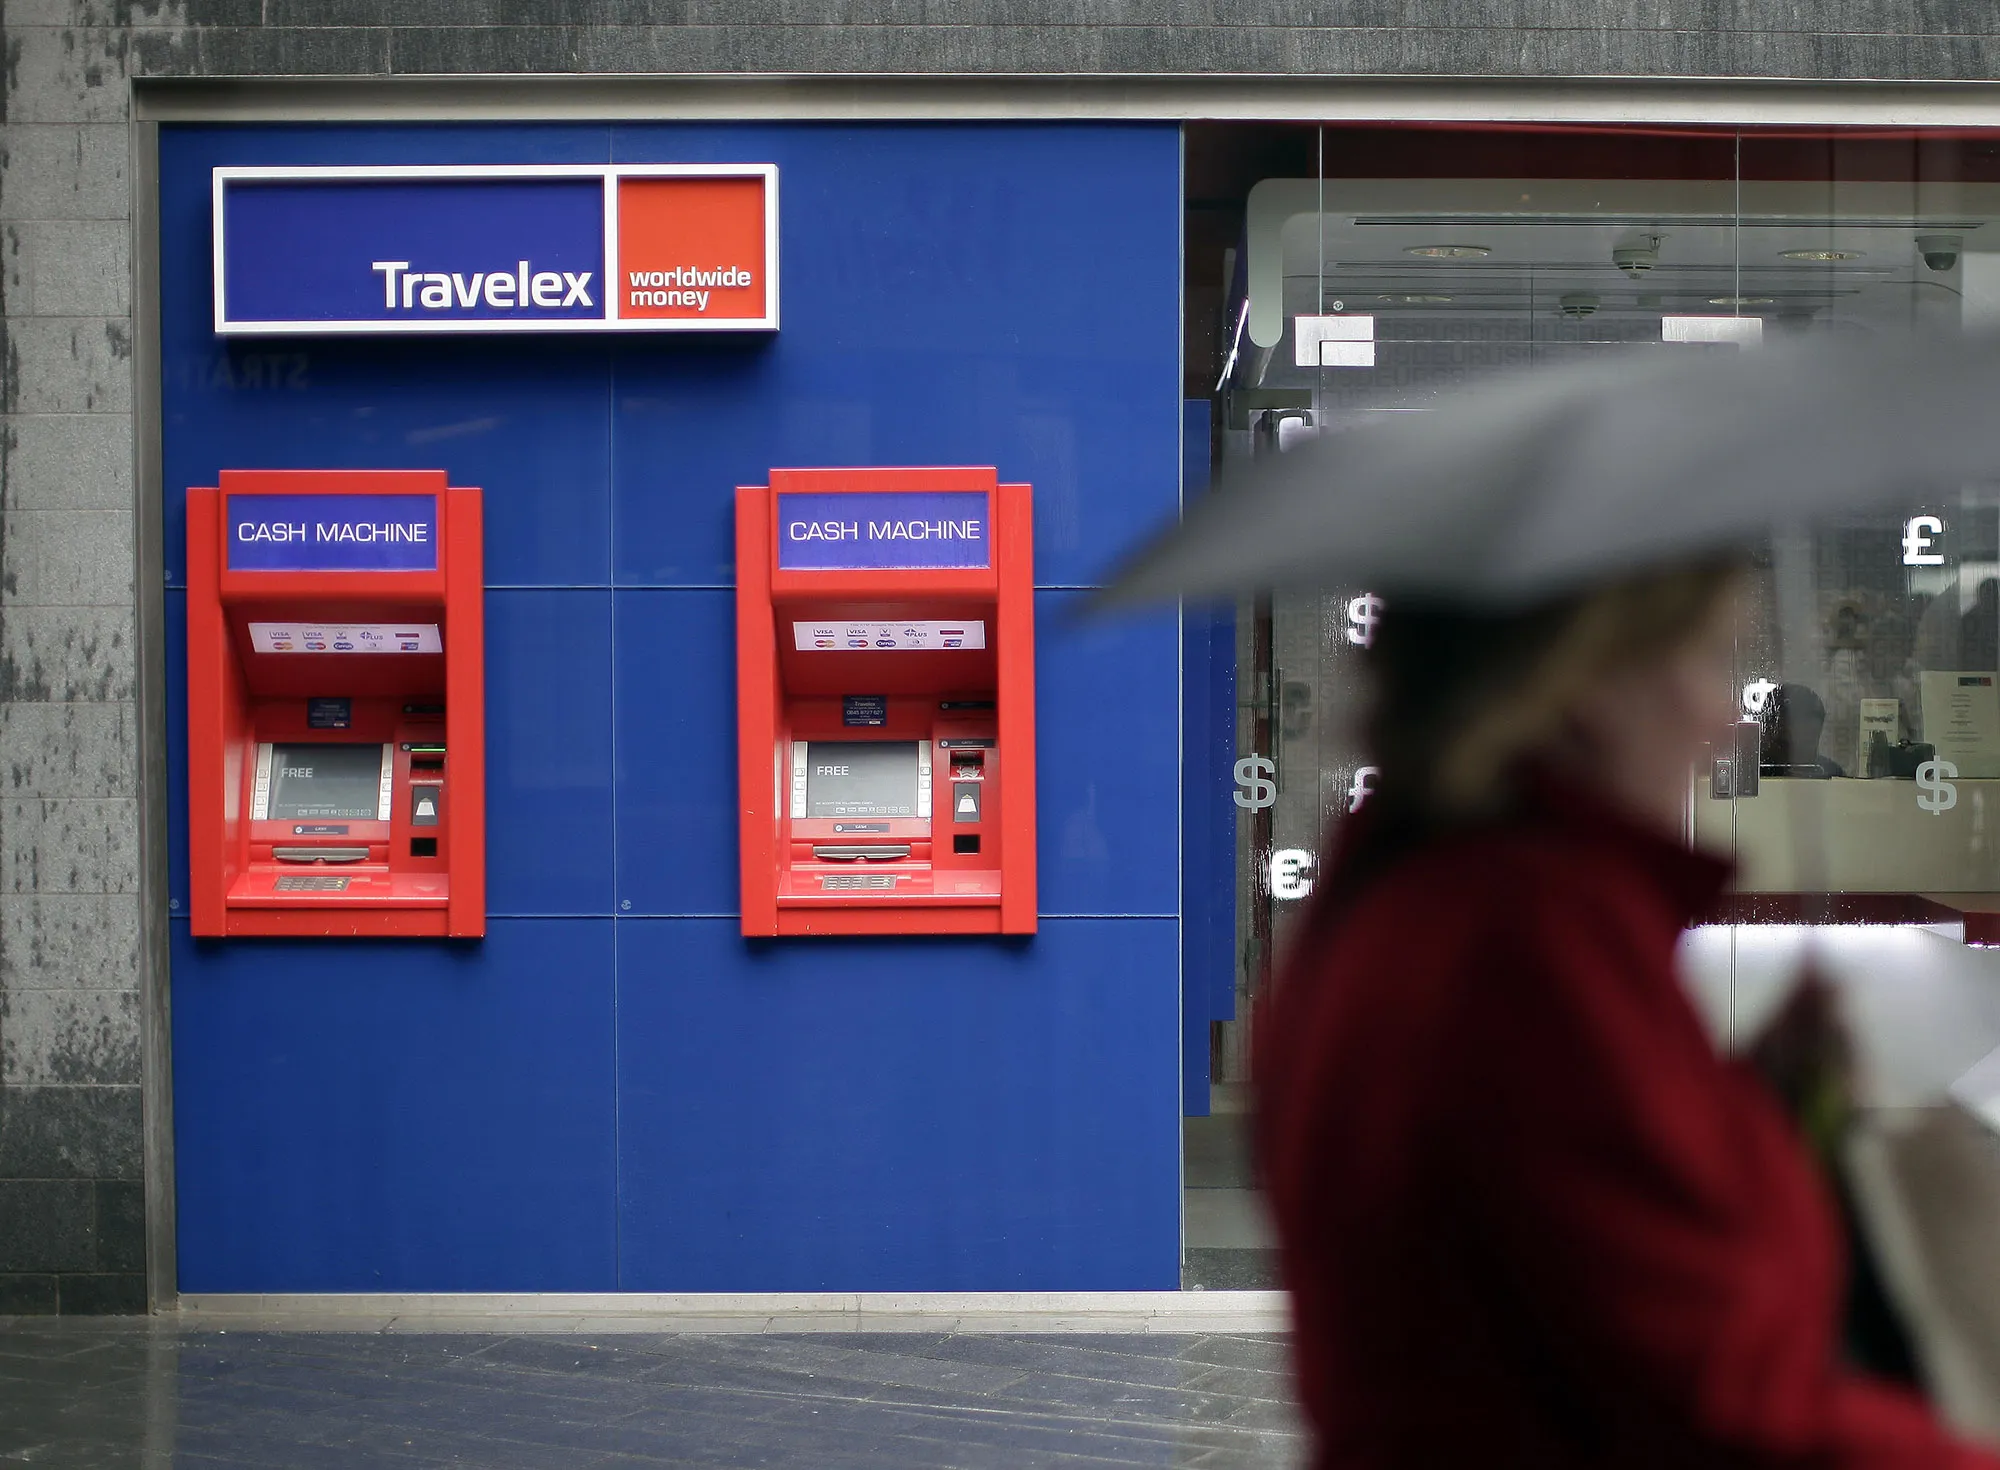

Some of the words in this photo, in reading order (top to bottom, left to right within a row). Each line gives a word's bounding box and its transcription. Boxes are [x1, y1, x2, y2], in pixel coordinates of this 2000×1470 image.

[373, 260, 594, 309] Travelex
[629, 265, 751, 288] worldwide
[629, 289, 710, 312] money
[237, 522, 305, 543] CASH
[316, 522, 428, 543] MACHINE
[789, 520, 858, 541] CASH
[868, 520, 981, 541] MACHINE
[1902, 515, 1945, 566] £
[280, 767, 314, 778] FREE
[816, 765, 849, 776] FREE
[1233, 753, 1276, 813] $
[1915, 755, 1958, 815] $
